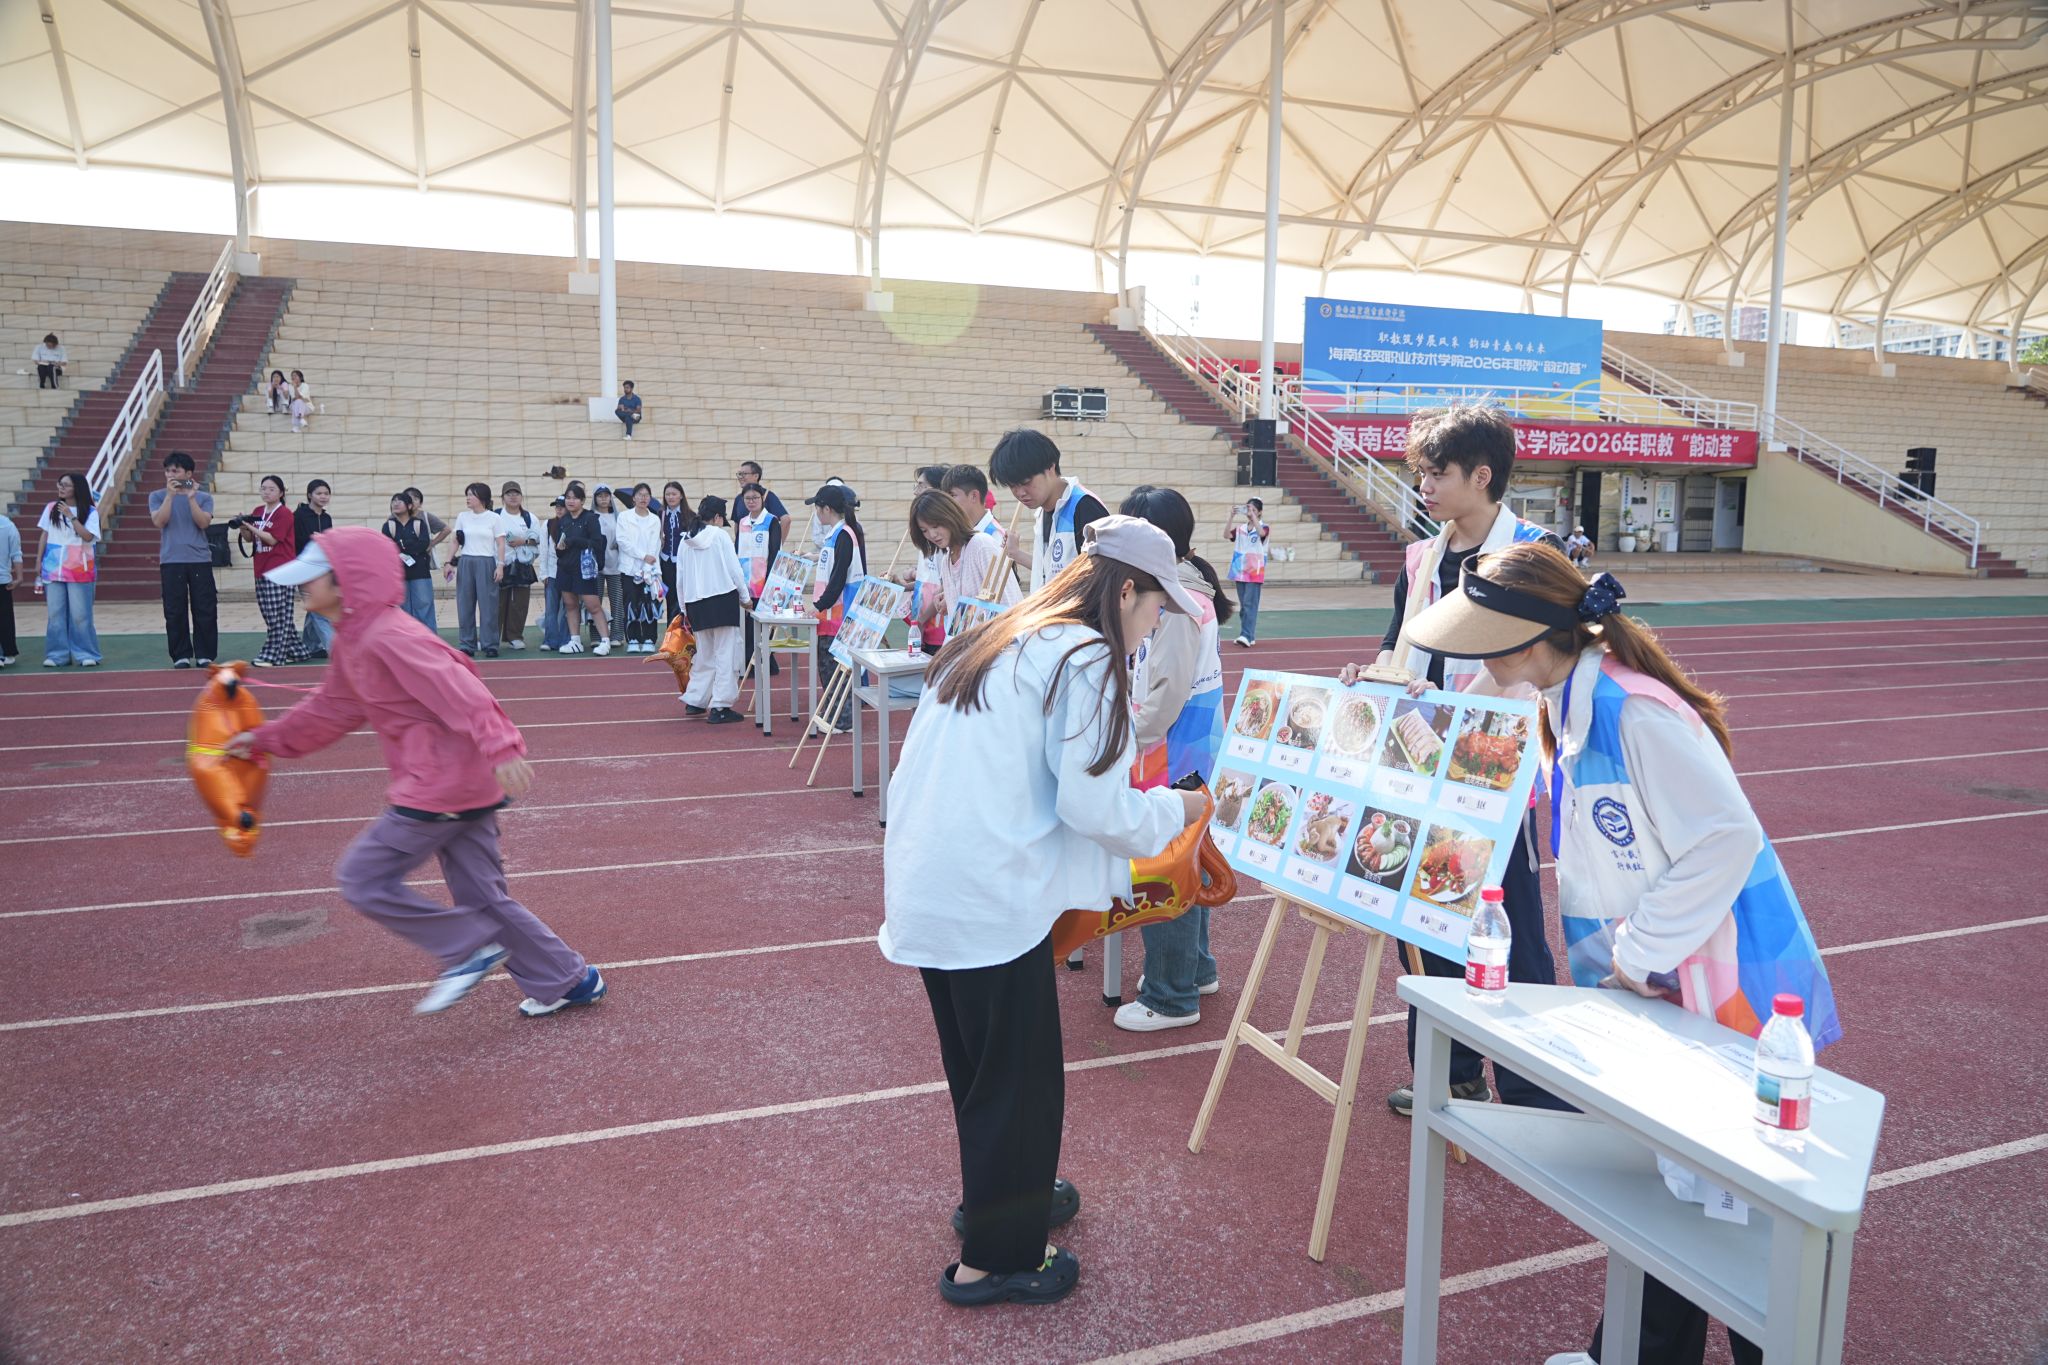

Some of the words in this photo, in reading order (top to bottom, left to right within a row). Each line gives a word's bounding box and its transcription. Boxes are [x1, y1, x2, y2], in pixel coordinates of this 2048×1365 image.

[1469, 337, 1546, 354] 韵动青春向未来
